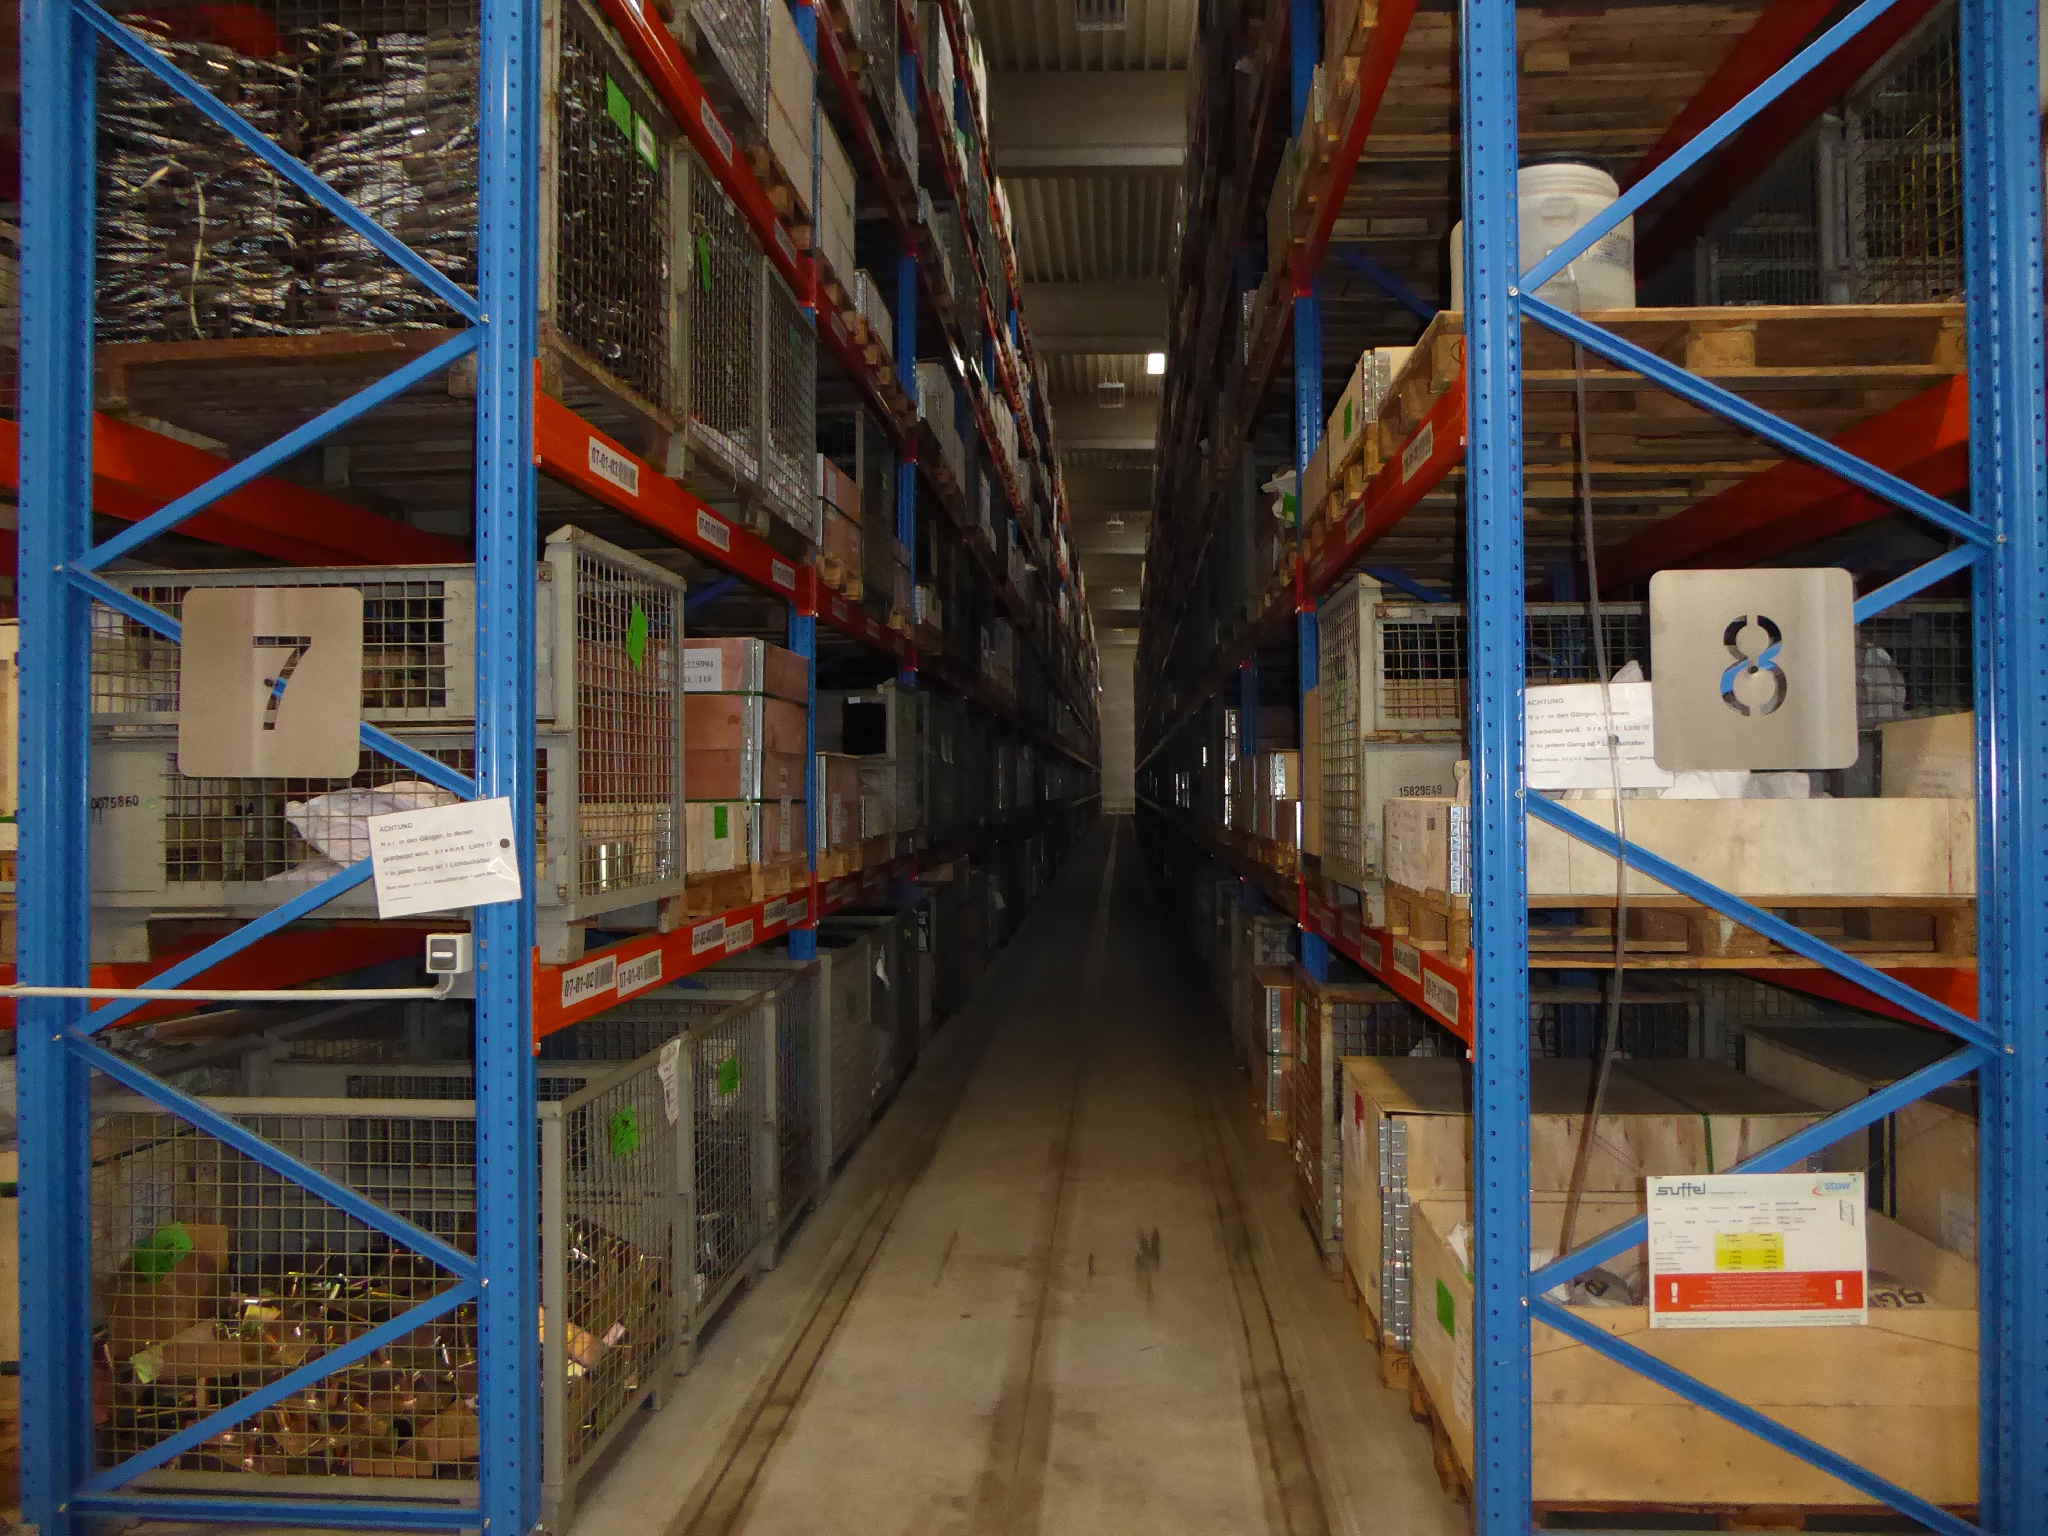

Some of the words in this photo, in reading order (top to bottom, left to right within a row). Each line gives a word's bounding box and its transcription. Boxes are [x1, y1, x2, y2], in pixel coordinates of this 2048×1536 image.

[253, 635, 312, 731] 7
[1720, 615, 1788, 717] 8
[1655, 1181, 1706, 1198] suffel
